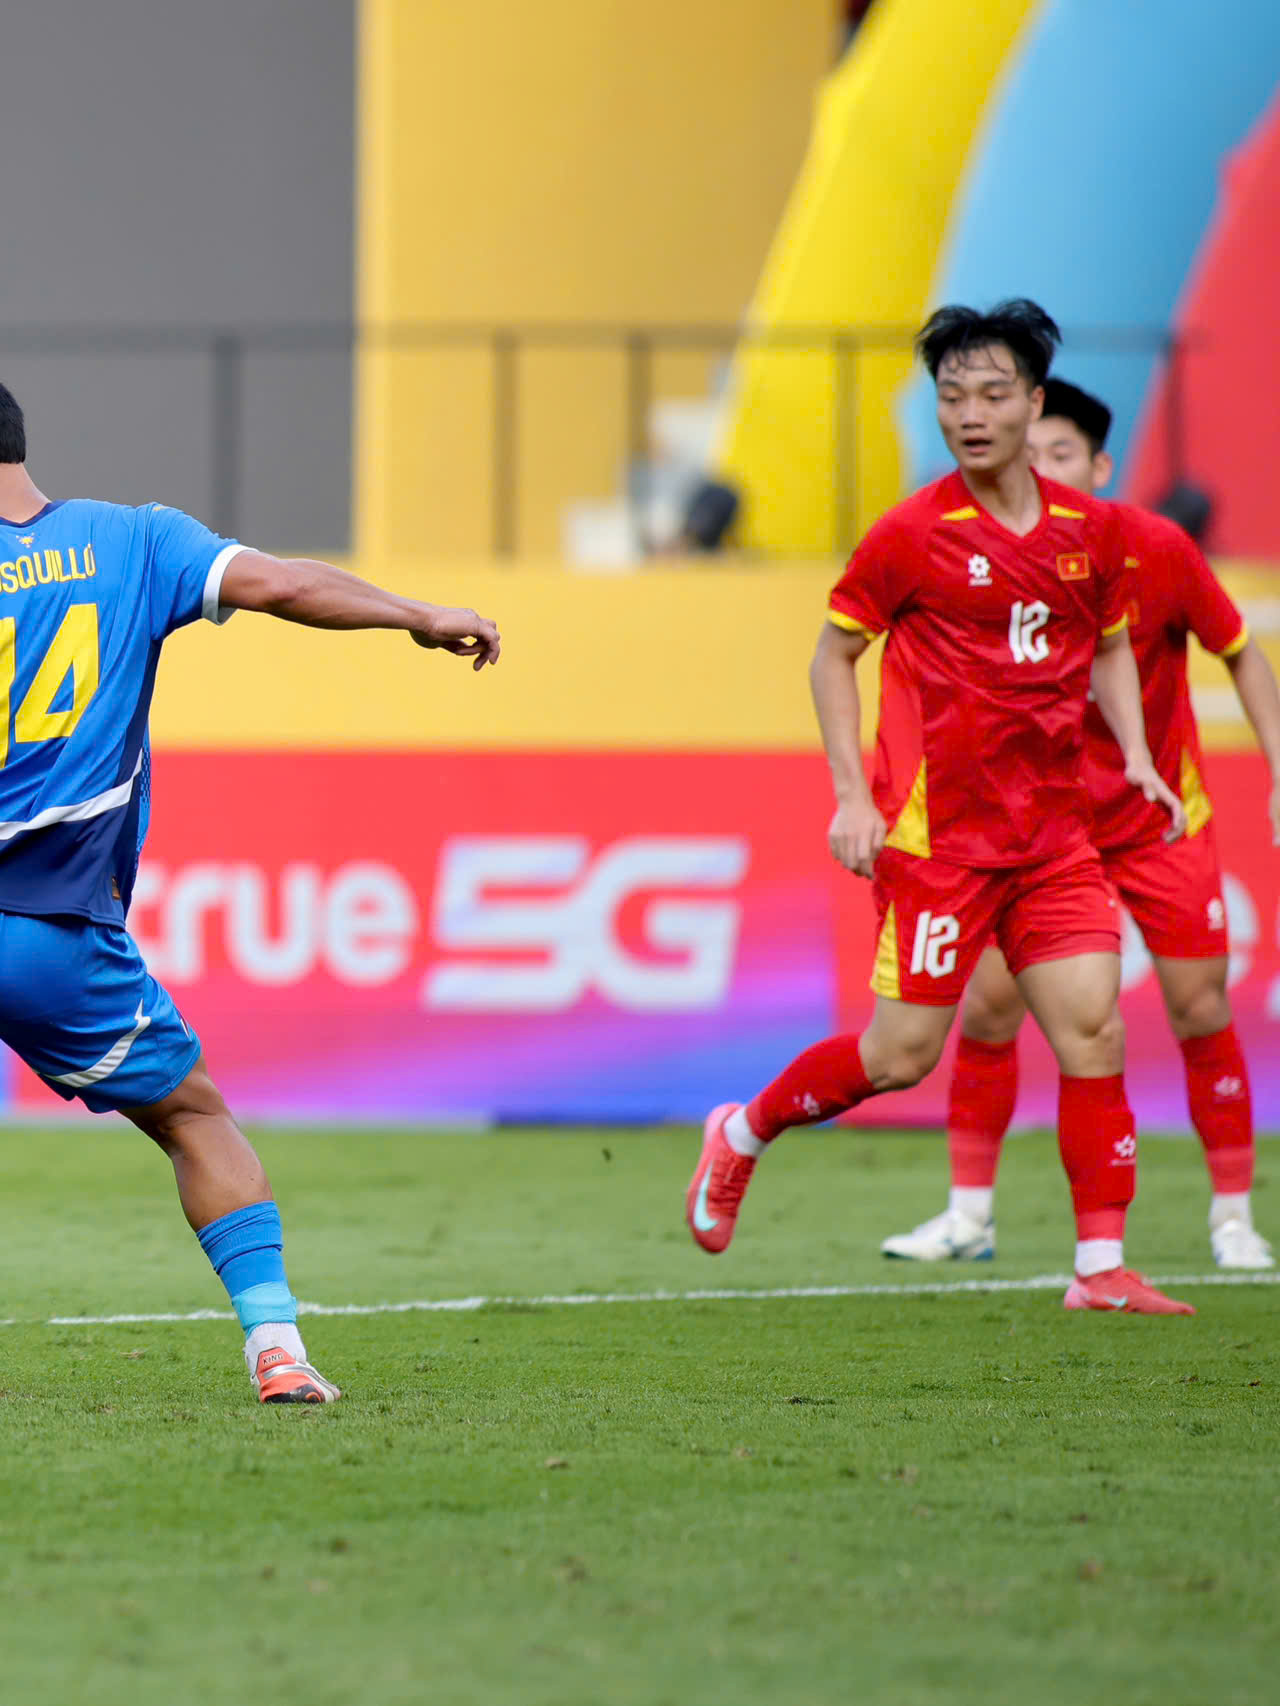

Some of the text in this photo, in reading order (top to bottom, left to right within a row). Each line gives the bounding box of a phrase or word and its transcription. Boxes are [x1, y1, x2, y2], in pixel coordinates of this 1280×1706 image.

[1008, 600, 1051, 664] 12
[422, 834, 750, 1012] 5G
[910, 911, 960, 978] 12
[263, 1353, 284, 1365] KING
